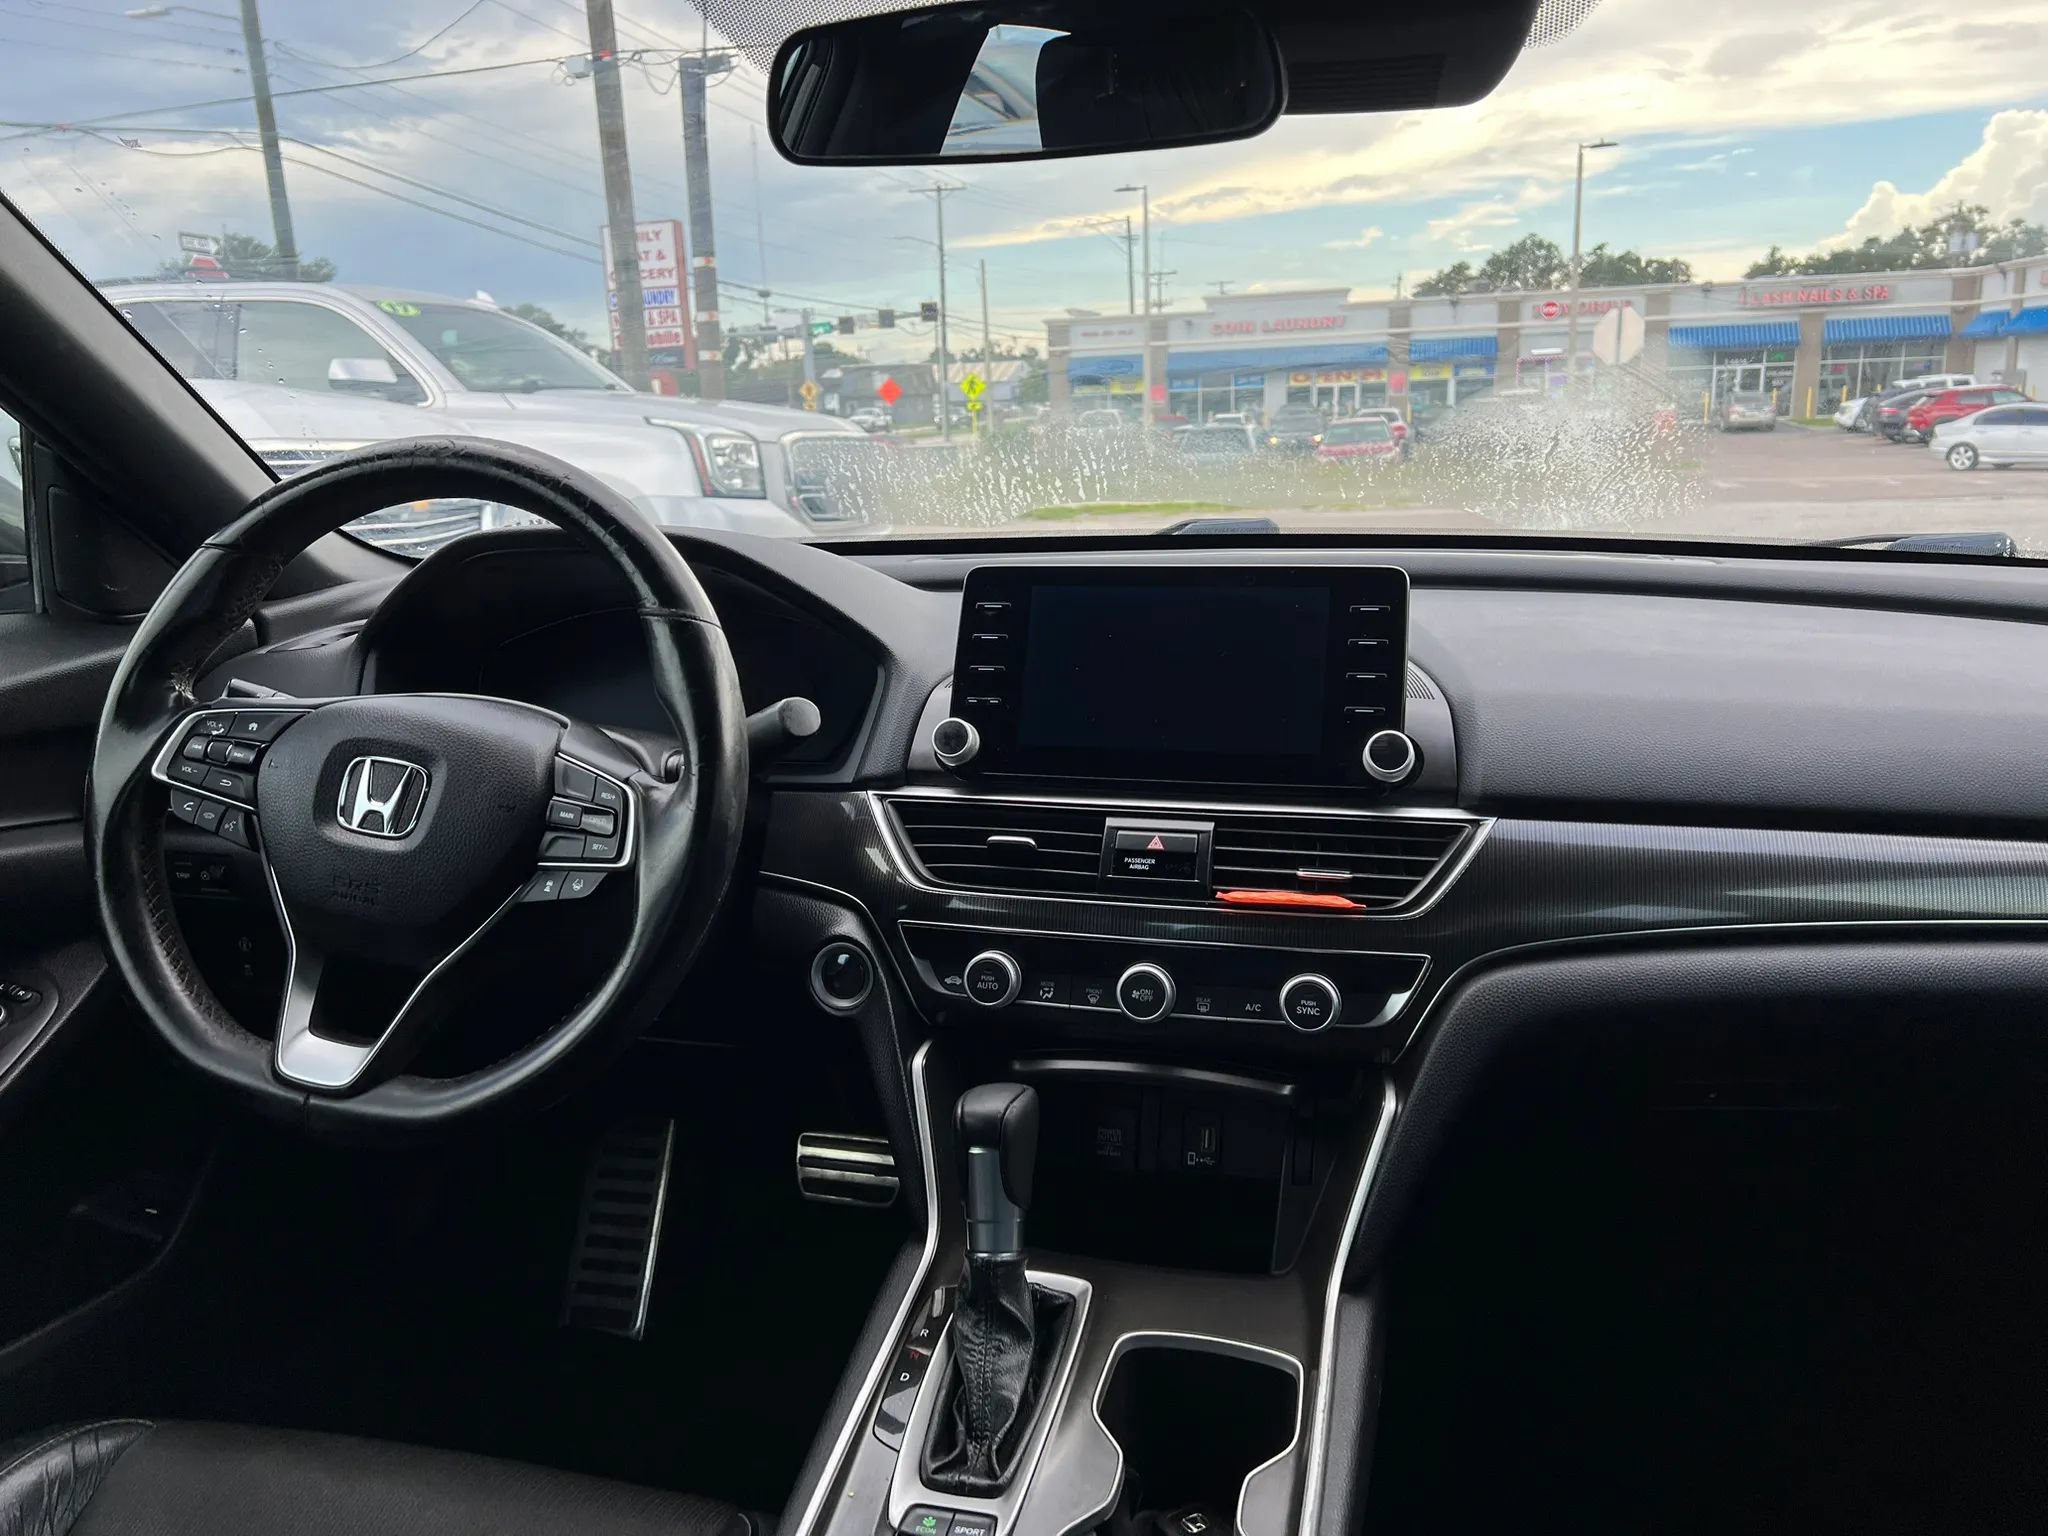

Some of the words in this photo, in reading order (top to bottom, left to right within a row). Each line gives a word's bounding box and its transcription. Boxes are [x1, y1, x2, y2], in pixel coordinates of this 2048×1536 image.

[1797, 287, 1842, 303] NAILS
[1847, 287, 1857, 302] &
[1863, 284, 1890, 300] SPA
[1210, 321, 1255, 336] COIN
[1260, 315, 1346, 332] LAUNDRY
[976, 981, 999, 990] AUTO
[1244, 1003, 1262, 1012] A/C
[1300, 999, 1316, 1007] PUSH
[1296, 1006, 1321, 1016] SYNC
[920, 1328, 929, 1337] R
[900, 1372, 910, 1381] D
[915, 1525, 937, 1536] ECON
[954, 1525, 986, 1536] SPORT
